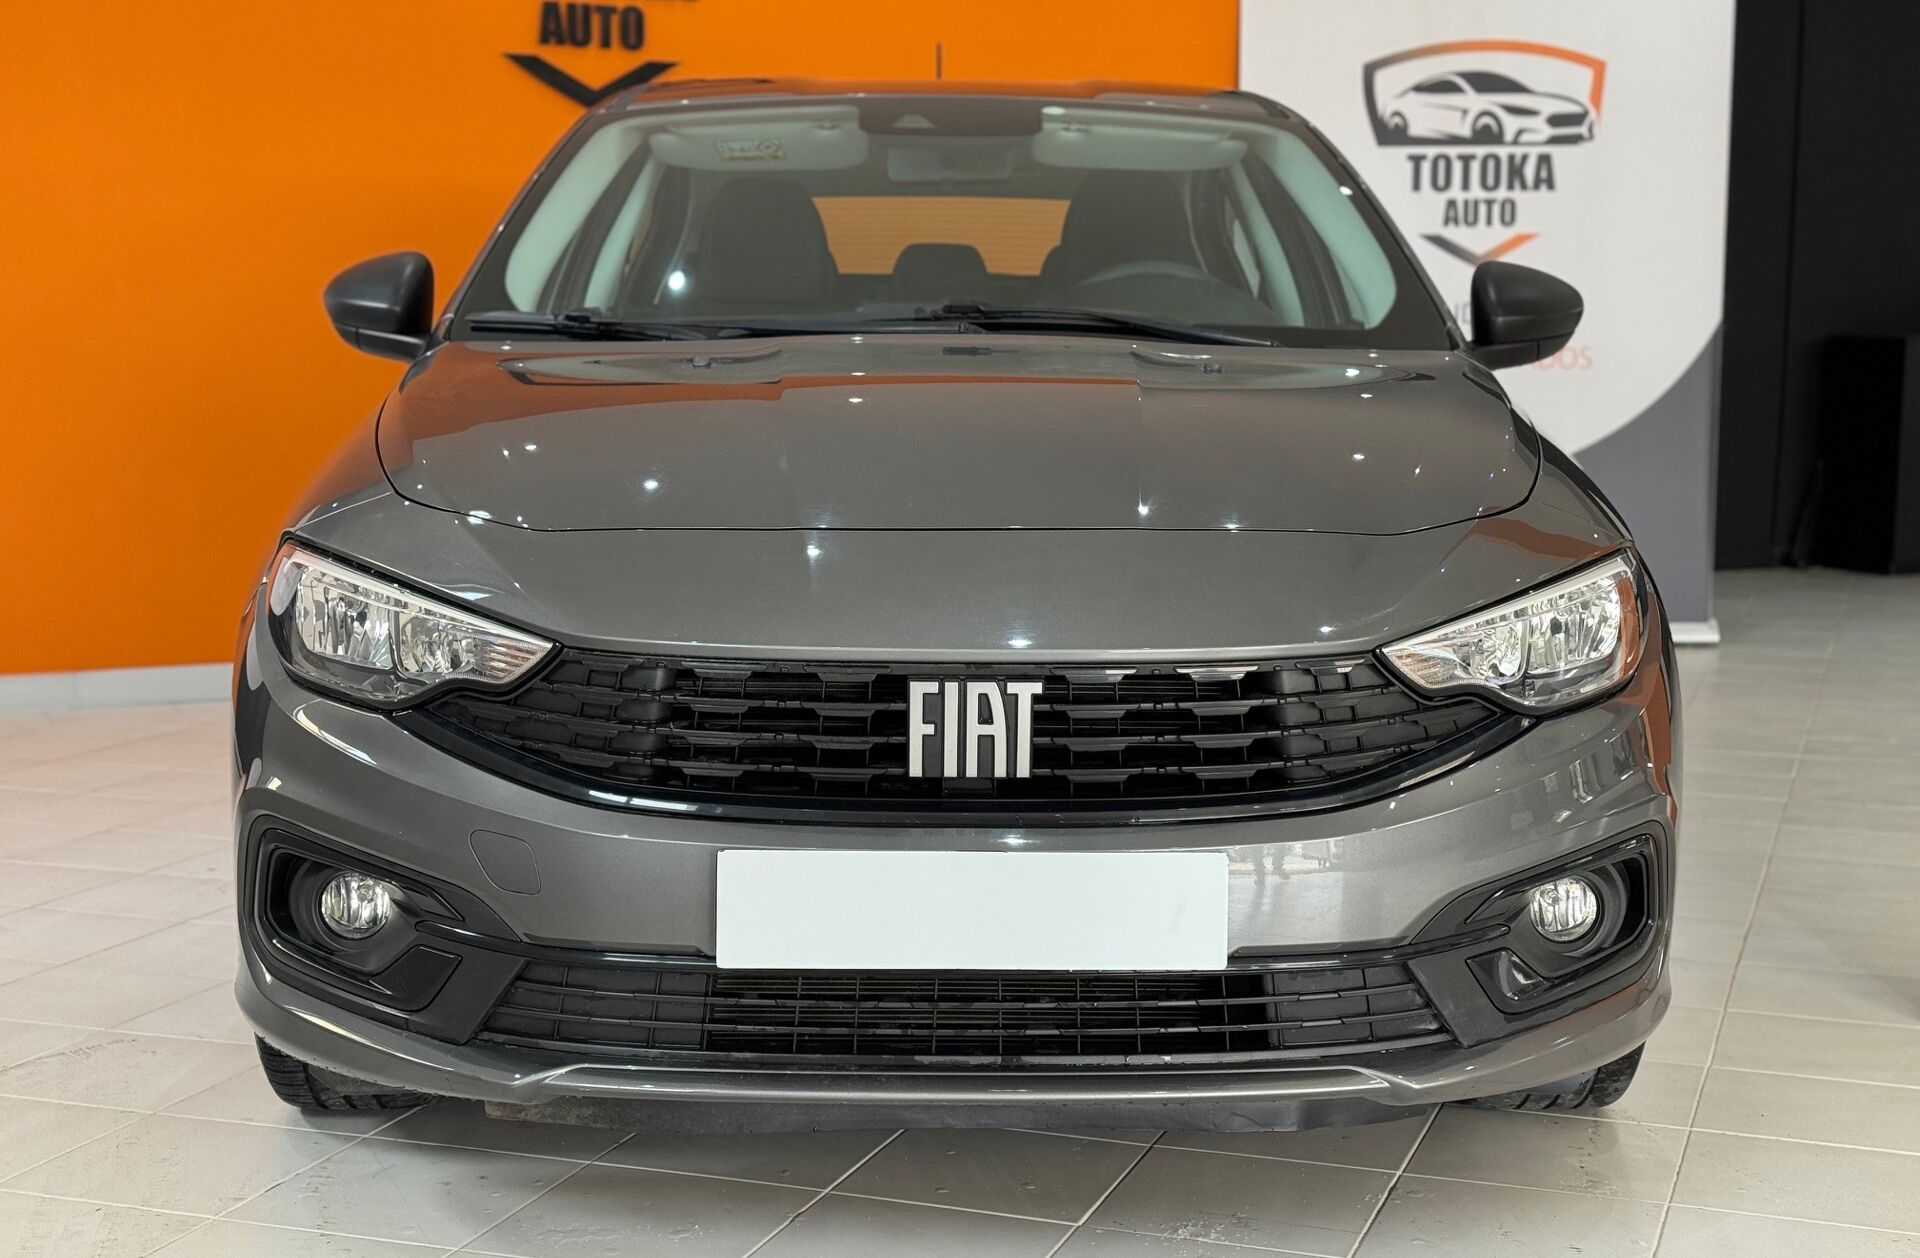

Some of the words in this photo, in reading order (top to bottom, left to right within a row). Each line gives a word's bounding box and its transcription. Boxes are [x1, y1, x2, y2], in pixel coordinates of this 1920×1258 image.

[539, 2, 645, 50] AUTO
[1407, 153, 1556, 192] TOTOKA
[1443, 198, 1517, 228] AUTO
[909, 681, 1043, 778] FIAT
